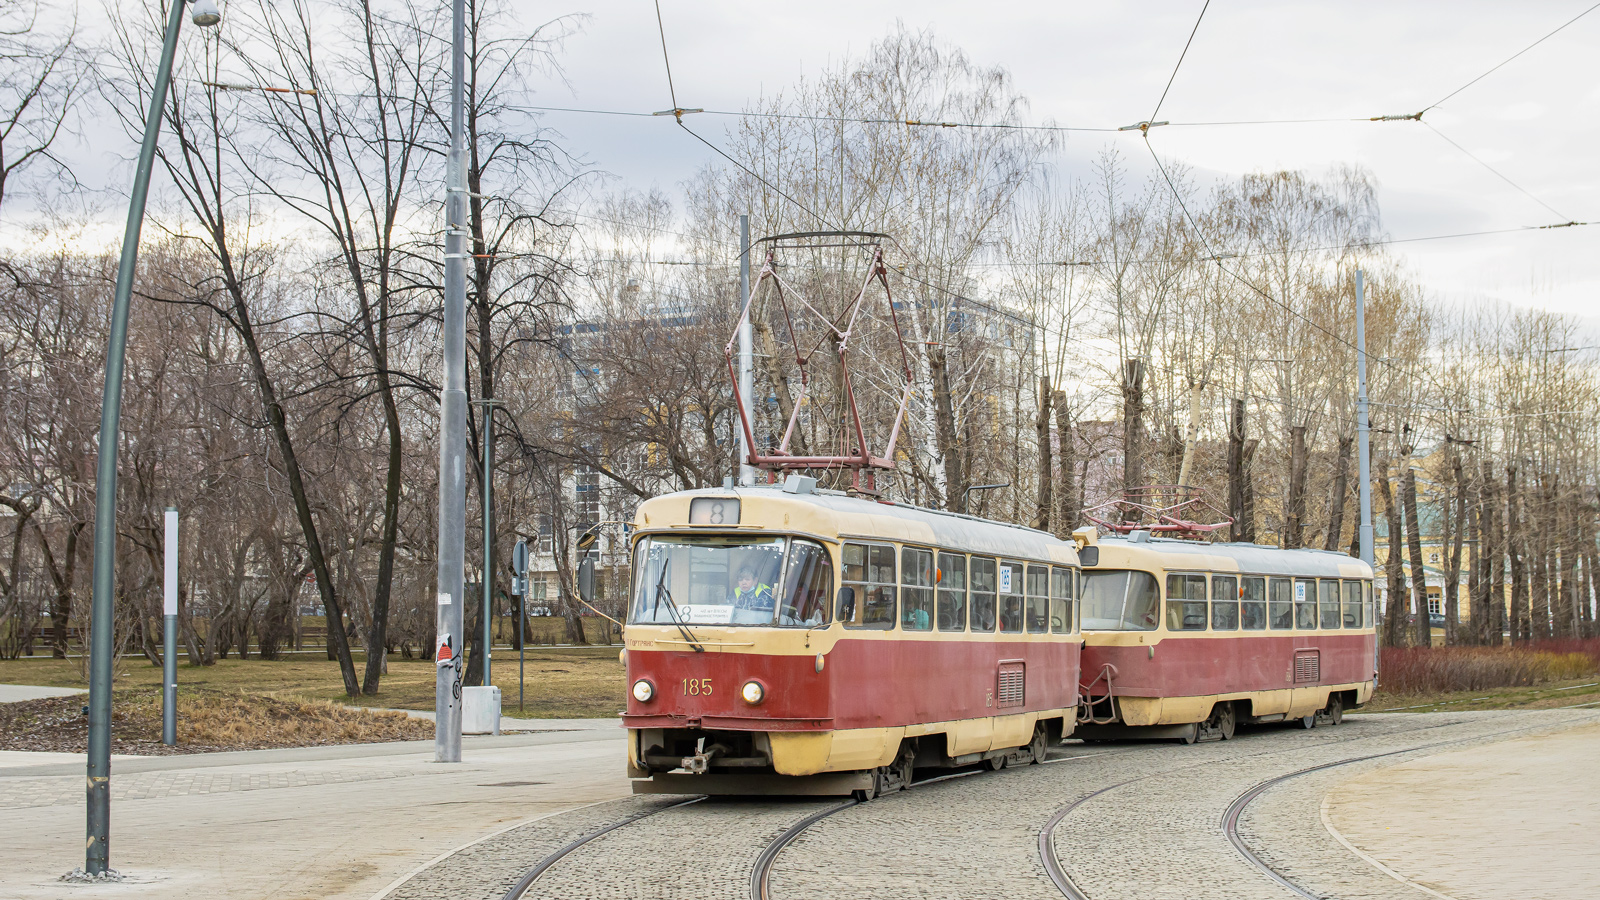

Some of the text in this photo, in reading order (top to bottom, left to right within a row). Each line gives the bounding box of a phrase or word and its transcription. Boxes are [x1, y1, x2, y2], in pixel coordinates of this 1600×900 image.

[710, 502, 724, 524] 8
[680, 606, 691, 622] 8
[683, 678, 713, 697] 185
